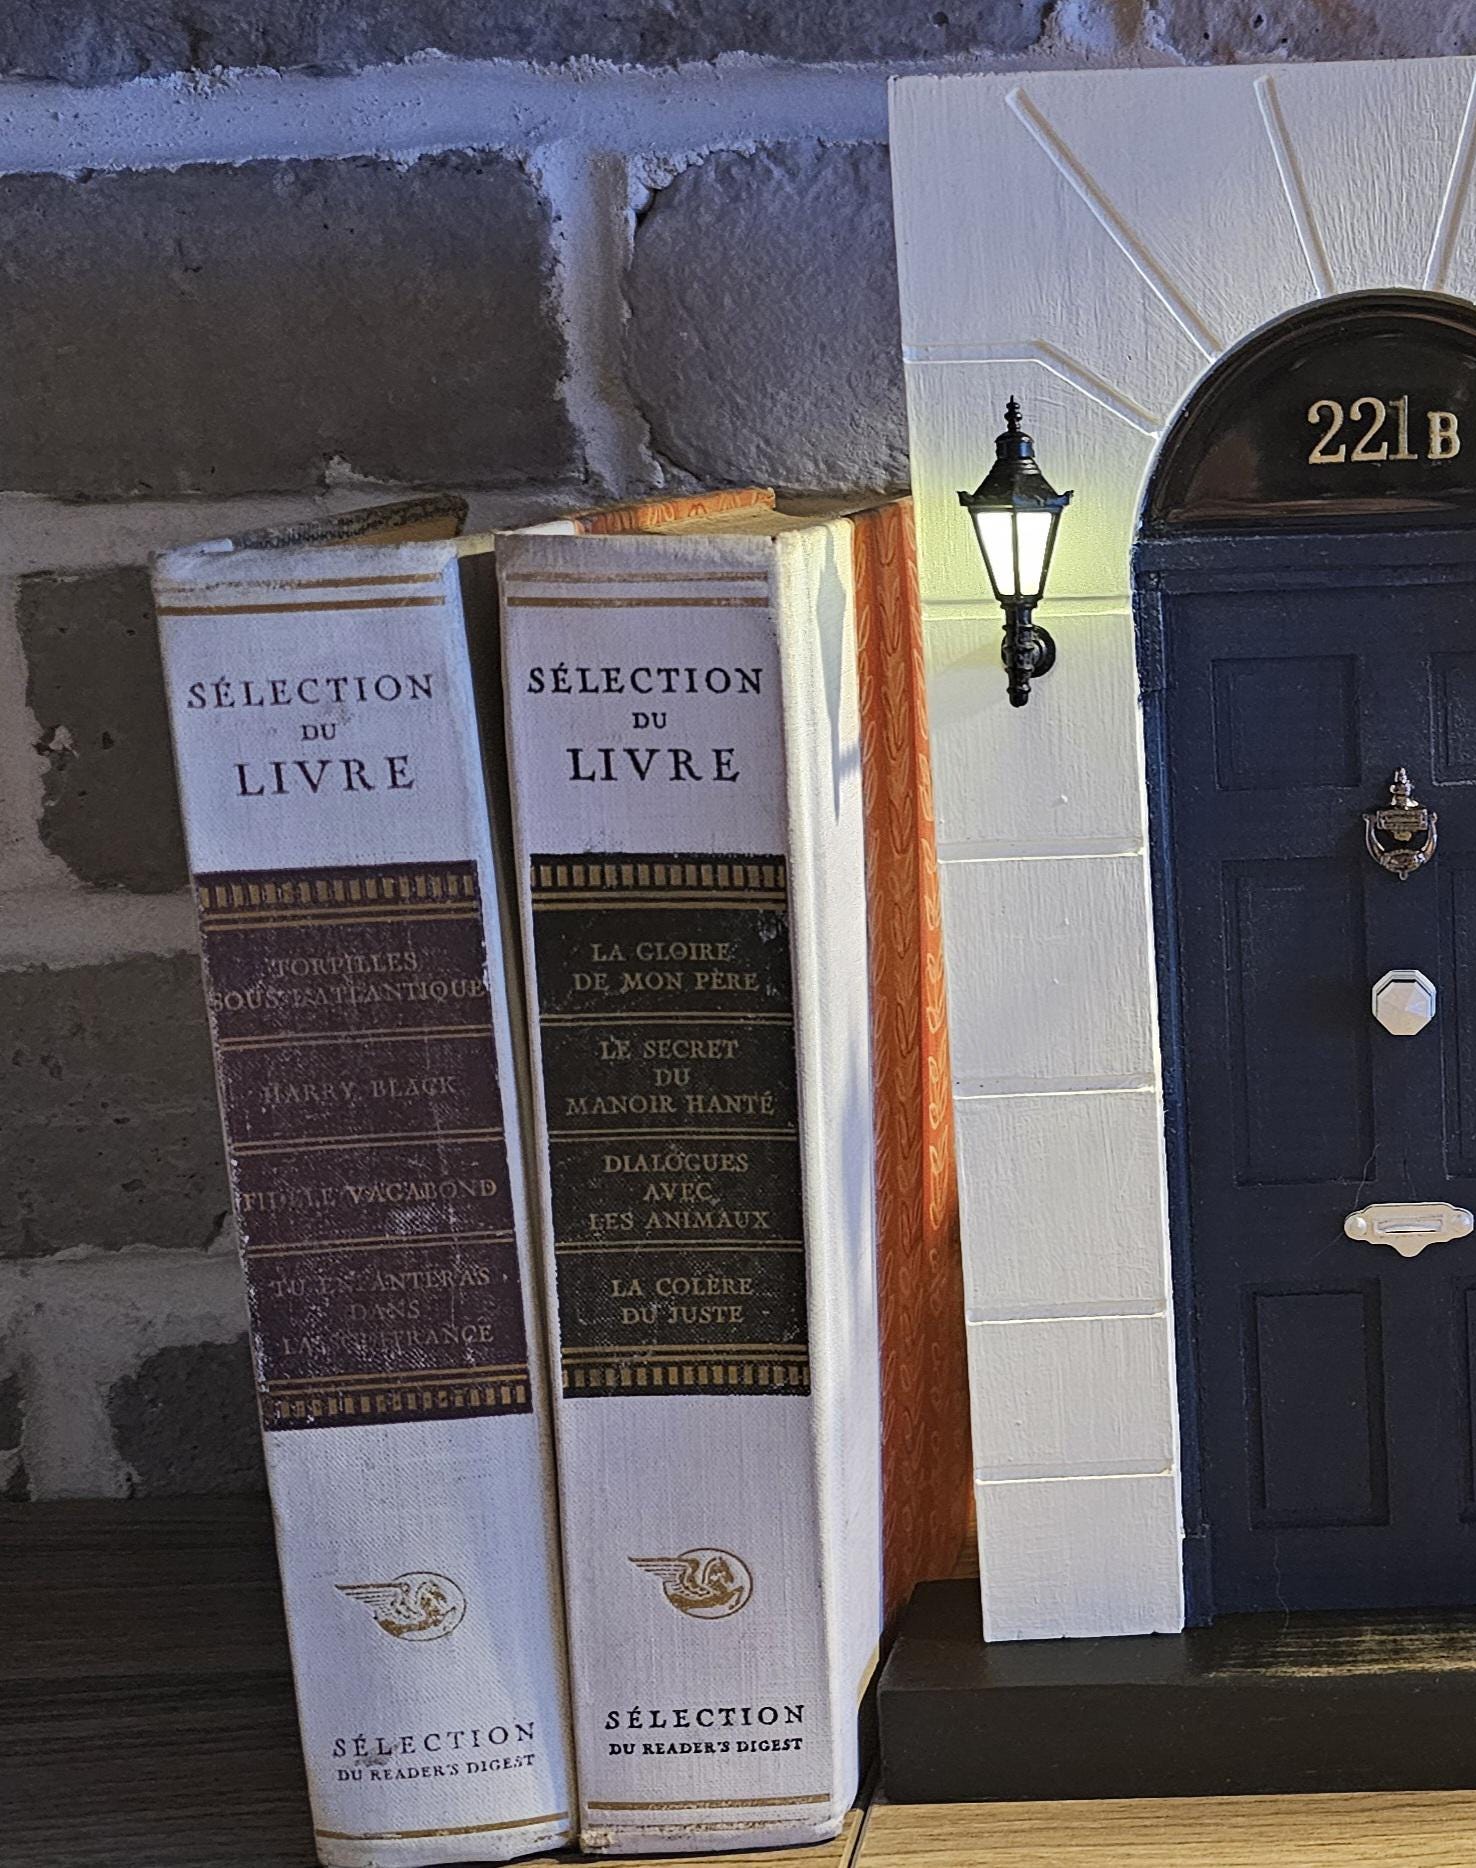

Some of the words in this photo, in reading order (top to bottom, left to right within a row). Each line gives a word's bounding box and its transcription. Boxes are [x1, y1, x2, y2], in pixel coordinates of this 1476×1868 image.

[527, 662, 763, 695] SÉLECTION
[187, 673, 434, 709] SÉLECTION
[301, 723, 337, 741] DU
[632, 711, 667, 730] DU
[234, 755, 416, 797] LIVRE
[566, 748, 740, 783] LIVRE
[273, 950, 418, 978] TORPILLES
[591, 943, 626, 962] LA
[637, 942, 732, 962] GLOIRE
[574, 973, 609, 992] DE
[621, 972, 683, 992] MON
[694, 968, 760, 992] PÈRE
[600, 1040, 632, 1061] LE
[643, 1039, 739, 1061] SECRET
[371, 1076, 457, 1098] BLACK
[654, 1067, 690, 1087] DU
[566, 1095, 677, 1116] MANOIR
[684, 1090, 776, 1116] HANTÉ
[603, 1152, 749, 1173] DIALOGUES
[345, 1179, 497, 1205] VAGABOND
[643, 1182, 713, 1202] AVEC
[589, 1211, 633, 1231] LES
[645, 1210, 770, 1230] ANIMAUX
[612, 1278, 643, 1298] LA
[656, 1274, 753, 1297] COLÈRE
[622, 1306, 657, 1326] DU
[668, 1305, 744, 1325] JUSTE
[605, 1705, 804, 1730] SÉLECTION
[333, 1722, 535, 1759] SÉLECTION
[609, 1743, 635, 1756] DU
[642, 1741, 730, 1756] READER'S
[736, 1738, 803, 1754] DIGEST
[337, 1768, 362, 1782] DU
[370, 1762, 459, 1781] READER'S
[466, 1753, 536, 1775] DIGEST
